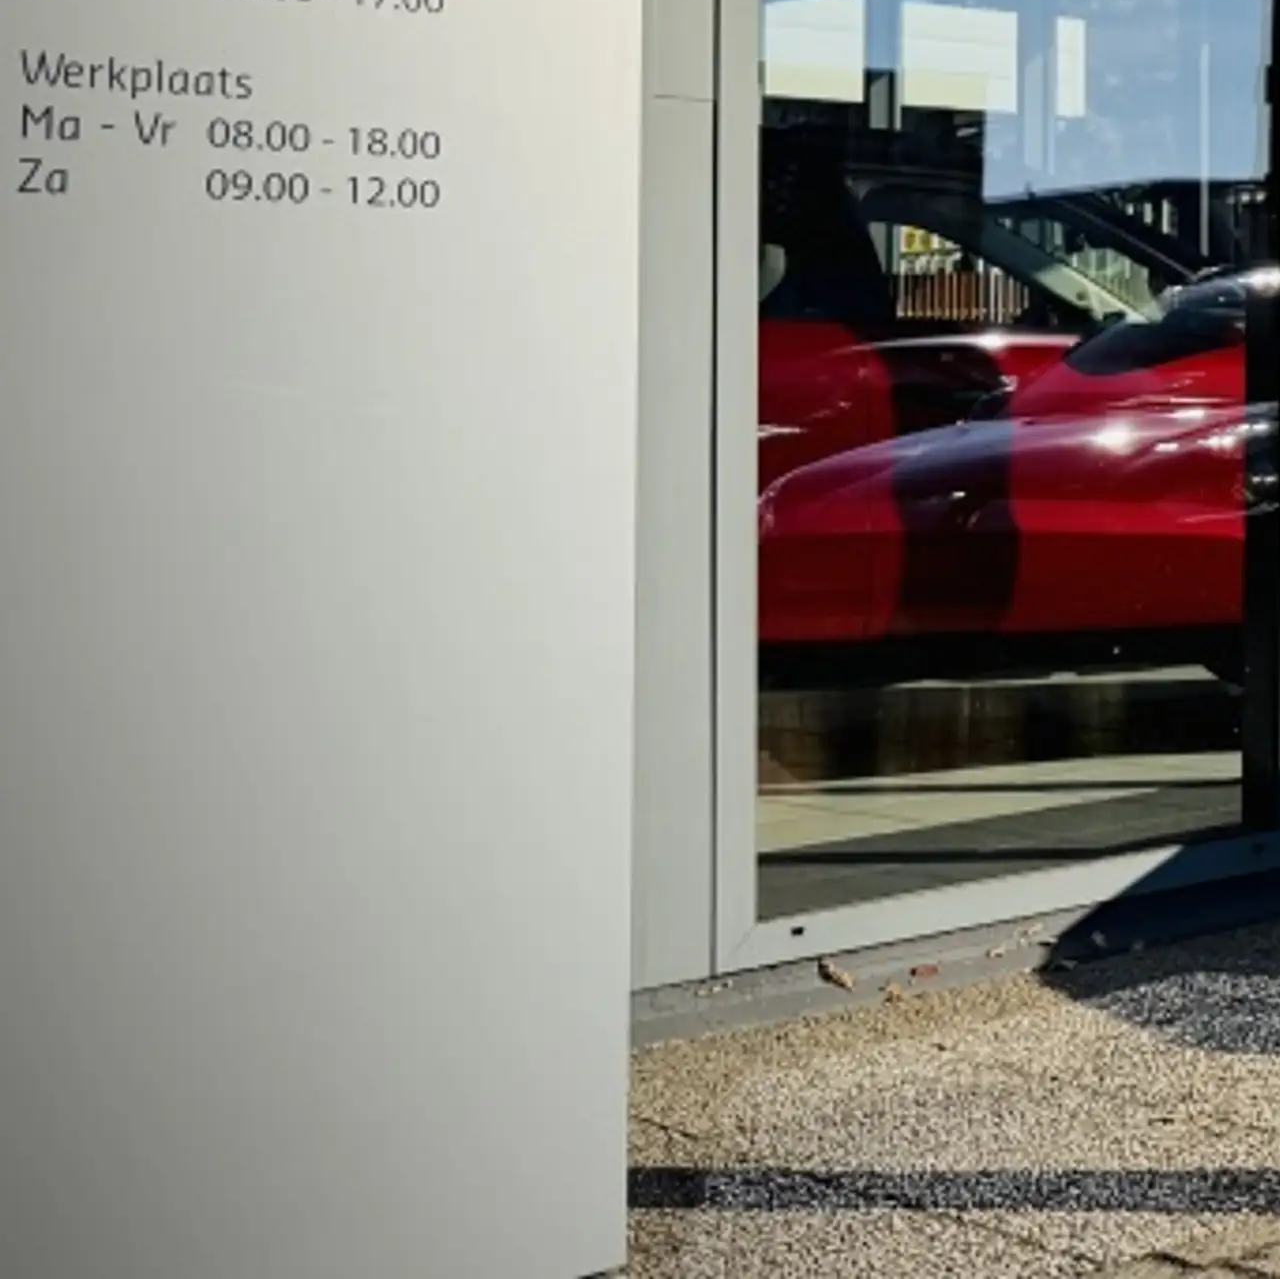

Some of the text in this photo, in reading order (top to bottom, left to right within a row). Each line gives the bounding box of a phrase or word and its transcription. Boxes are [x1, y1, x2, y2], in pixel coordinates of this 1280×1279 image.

[20, 49, 253, 101] Werkplaats
[20, 103, 81, 142] Ma
[133, 109, 177, 147] Vr
[206, 116, 312, 153] 08.00
[348, 126, 441, 160] 18.00
[16, 157, 69, 196] Za
[205, 168, 310, 205] 09.00
[347, 175, 441, 209] 12.00
